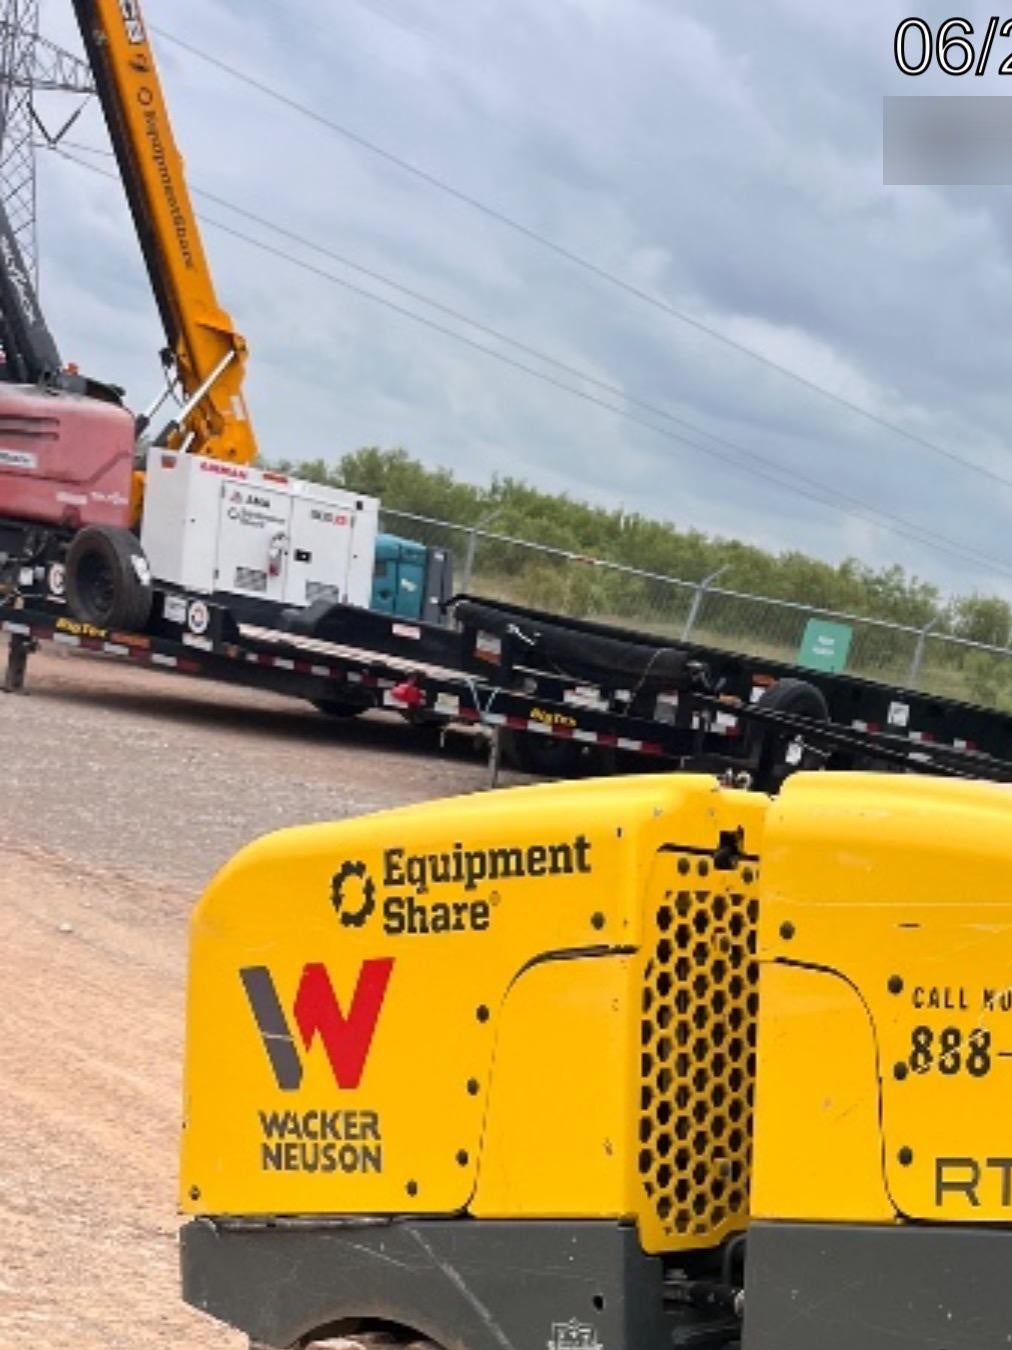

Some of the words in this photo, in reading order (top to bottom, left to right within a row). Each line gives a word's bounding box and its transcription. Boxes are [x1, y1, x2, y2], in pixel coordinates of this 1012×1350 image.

[383, 835, 591, 893] Equipment
[383, 895, 490, 935] Share
[912, 985, 970, 1009] CALL
[259, 1109, 382, 1141] WACKER
[261, 1142, 382, 1174] NEUSON
